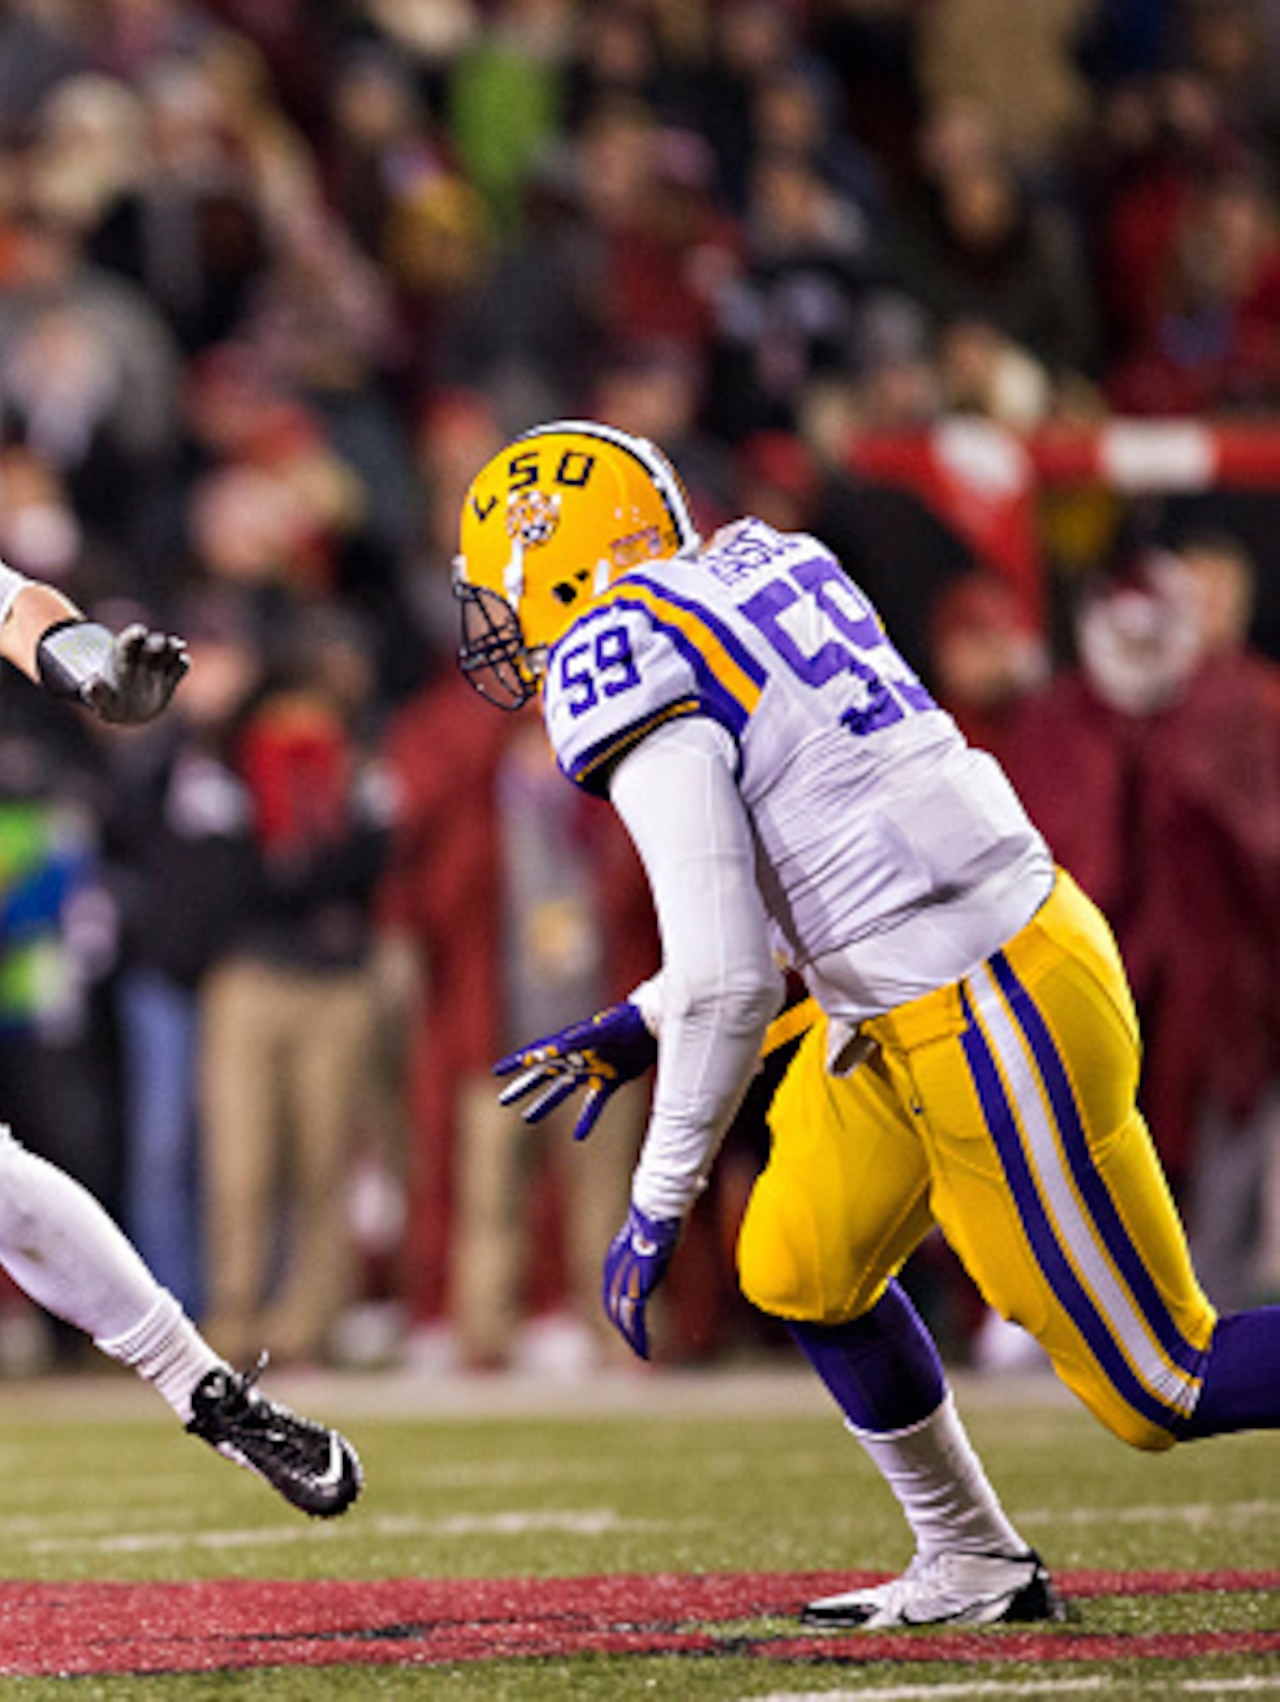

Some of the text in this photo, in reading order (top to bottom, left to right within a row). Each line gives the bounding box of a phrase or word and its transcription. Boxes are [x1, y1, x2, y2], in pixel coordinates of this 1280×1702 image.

[470, 449, 595, 522] LSU
[560, 626, 642, 716] 59
[737, 556, 940, 736] 59
